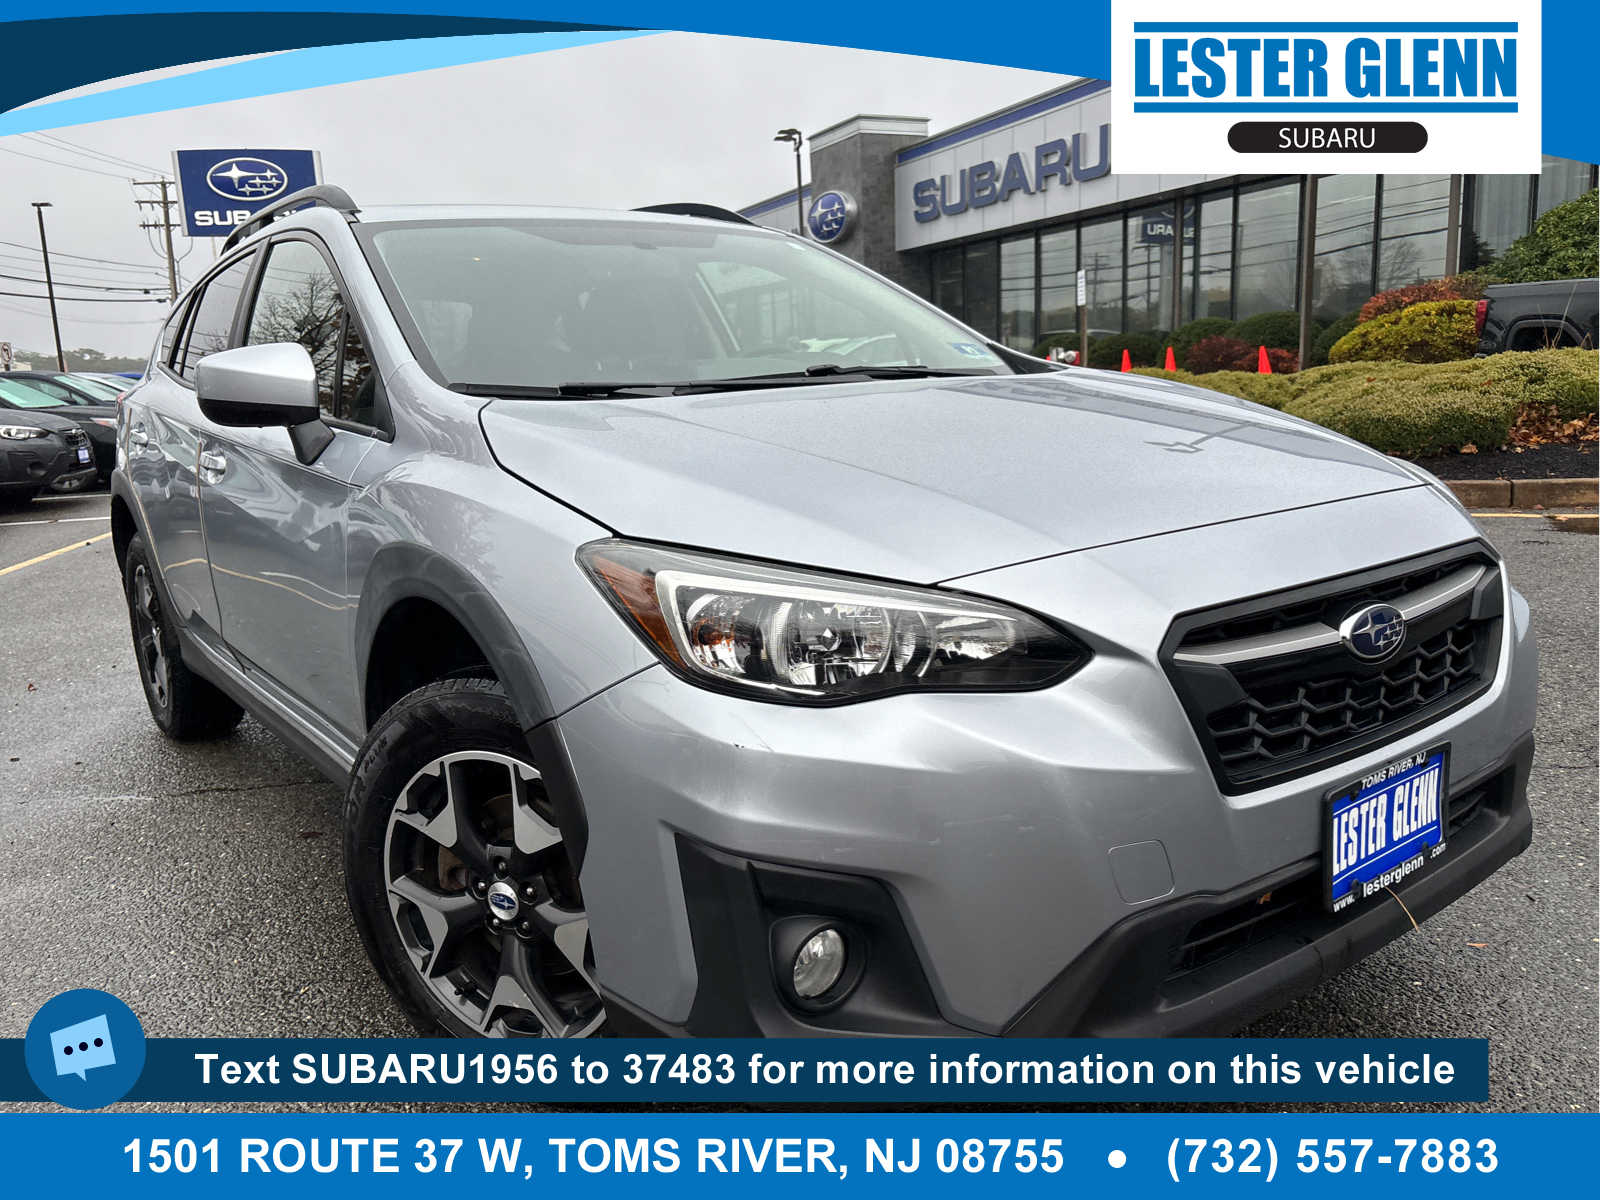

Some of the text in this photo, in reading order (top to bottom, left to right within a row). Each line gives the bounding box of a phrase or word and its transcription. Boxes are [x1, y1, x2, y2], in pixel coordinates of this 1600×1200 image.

[912, 123, 1111, 224] SUBARU
[1361, 751, 1427, 791] TOMS RIVER, NJ
[1333, 768, 1439, 876] LESTER GLENN
[1363, 855, 1424, 898] lesterglenn
